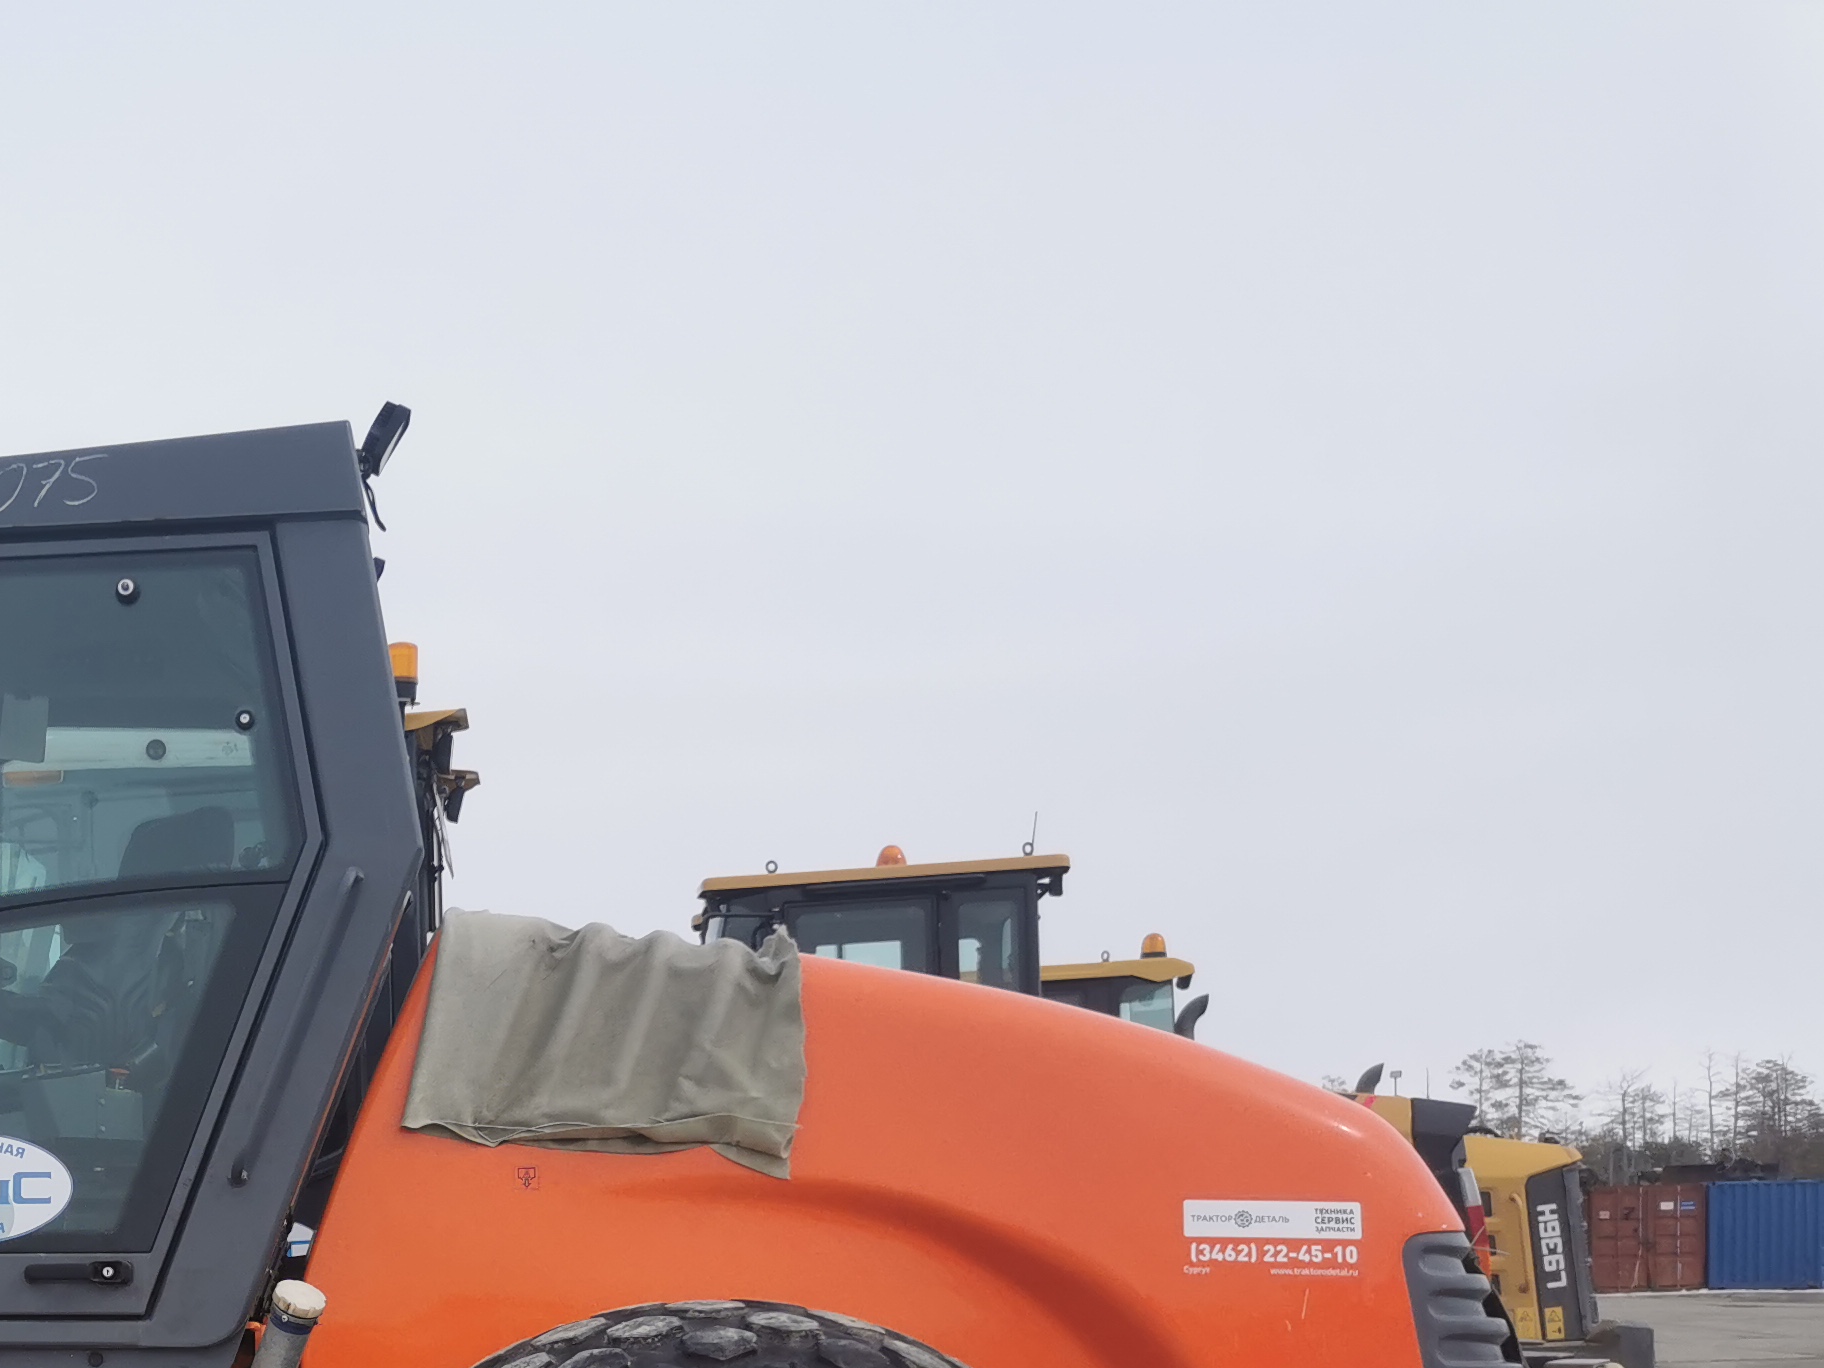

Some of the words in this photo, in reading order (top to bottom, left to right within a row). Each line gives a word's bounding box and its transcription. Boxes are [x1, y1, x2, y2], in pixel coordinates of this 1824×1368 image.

[1191, 1214, 1233, 1222] ТРАКТОР
[1254, 1215, 1290, 1224] ДЕТАЛЬ
[1314, 1217, 1356, 1225] СЕРВИС
[1191, 1242, 1257, 1263] (3462)
[1263, 1244, 1359, 1264] 22-45-10
[1536, 1203, 1567, 1289] L936H
